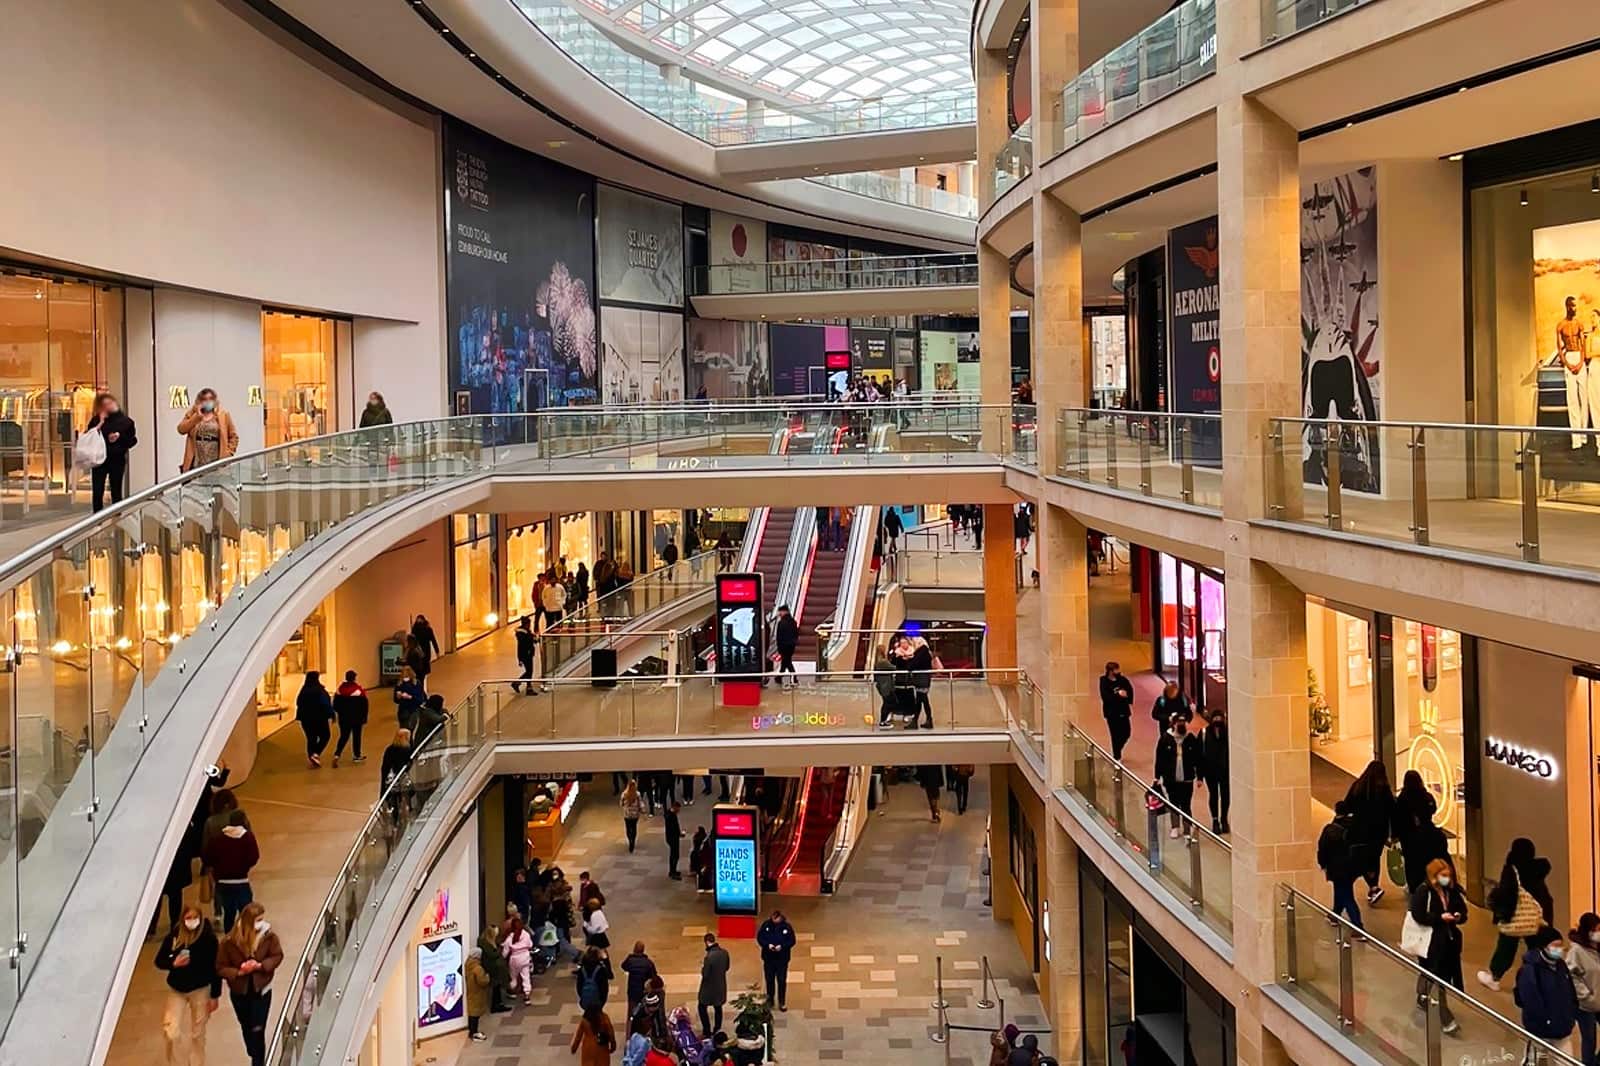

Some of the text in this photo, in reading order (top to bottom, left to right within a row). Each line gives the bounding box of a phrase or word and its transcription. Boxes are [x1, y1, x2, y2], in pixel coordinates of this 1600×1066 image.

[1191, 318, 1221, 342] MILIT
[1485, 738, 1553, 778] MANGO
[718, 847, 749, 860] HANDS
[719, 859, 741, 871] FACE
[719, 870, 748, 882] SPACE
